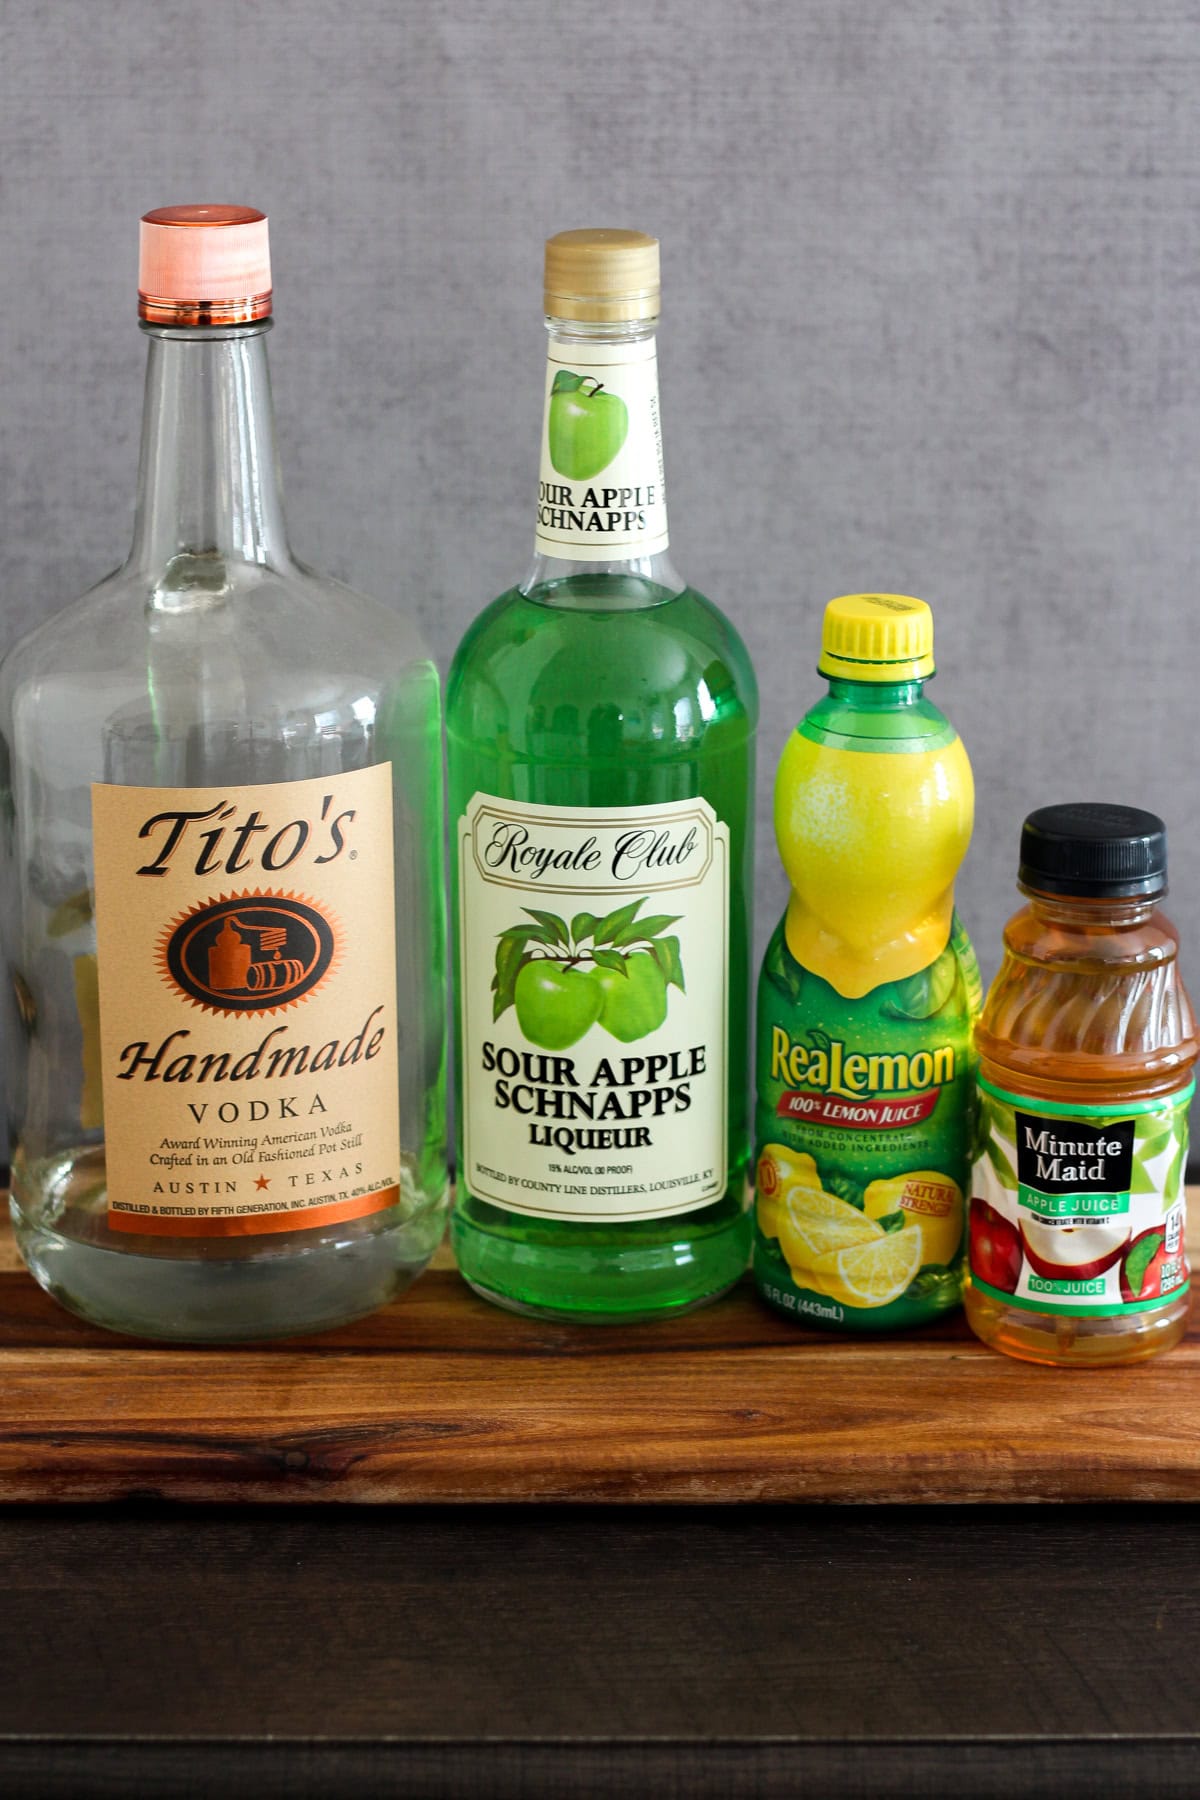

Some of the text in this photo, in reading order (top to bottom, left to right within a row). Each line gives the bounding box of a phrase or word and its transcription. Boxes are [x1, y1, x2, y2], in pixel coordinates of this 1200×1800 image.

[539, 481, 656, 509] OUR APPLE
[135, 794, 358, 877] Tito's
[484, 821, 698, 881] Royale Club
[116, 1004, 386, 1084] Handmade
[481, 1041, 707, 1088] SOUR APPLE
[187, 1093, 329, 1125] VODKA
[494, 1079, 692, 1121] SCHNAPPS
[822, 1101, 879, 1123] LEMON
[879, 1103, 924, 1125] JUICE
[150, 1133, 364, 1170] Crafted in an Old Fashioned Pot Still
[160, 1121, 353, 1152] Award Winning American Vodka
[528, 1123, 654, 1156] LIQUEUR
[1024, 1126, 1123, 1157] Minute
[153, 1162, 364, 1194] AUSTIN TEXAS
[1036, 1153, 1107, 1182] Maid
[507, 1175, 520, 1187] BY
[520, 1178, 563, 1193] COUNTY
[563, 1184, 588, 1195] LINE
[589, 1183, 648, 1196] DISTILLERS,
[111, 1200, 152, 1214] DISTILLED
[151, 1205, 159, 1215] &
[159, 1205, 197, 1217] BOTTLED
[197, 1206, 210, 1216] BY
[210, 1204, 236, 1216] FIFTH
[236, 1199, 289, 1214] GENERATION,
[308, 1193, 338, 1206] AUSTIN,
[1026, 1193, 1120, 1213] APPLE JUICE
[1063, 1282, 1105, 1294] JUICE
[782, 1292, 797, 1311] OZ
[797, 1298, 845, 1323] (443mL)
